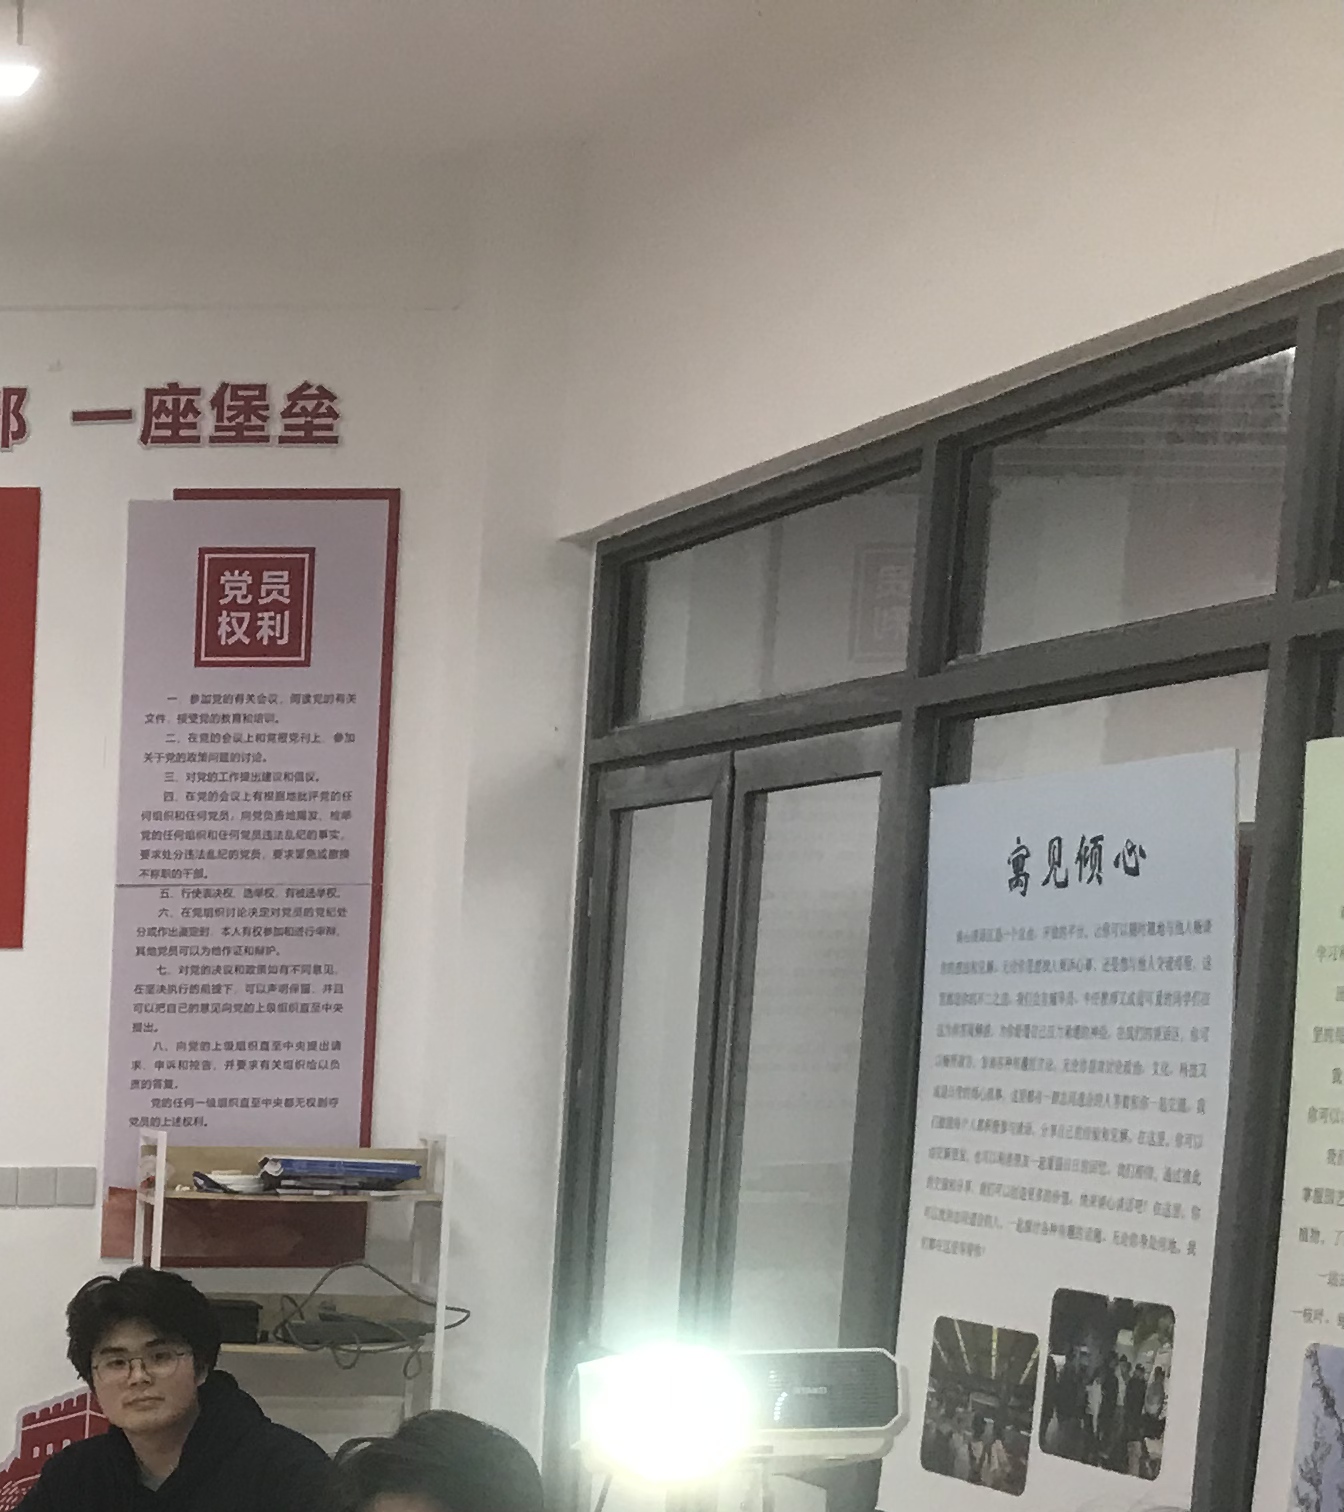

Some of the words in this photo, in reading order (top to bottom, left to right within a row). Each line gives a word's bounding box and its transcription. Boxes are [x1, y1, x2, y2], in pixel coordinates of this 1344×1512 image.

[71, 381, 341, 446] 一座堡垒
[219, 569, 292, 606] 党员
[217, 610, 291, 646] 权利
[1006, 833, 1147, 897] 寓见倾心
